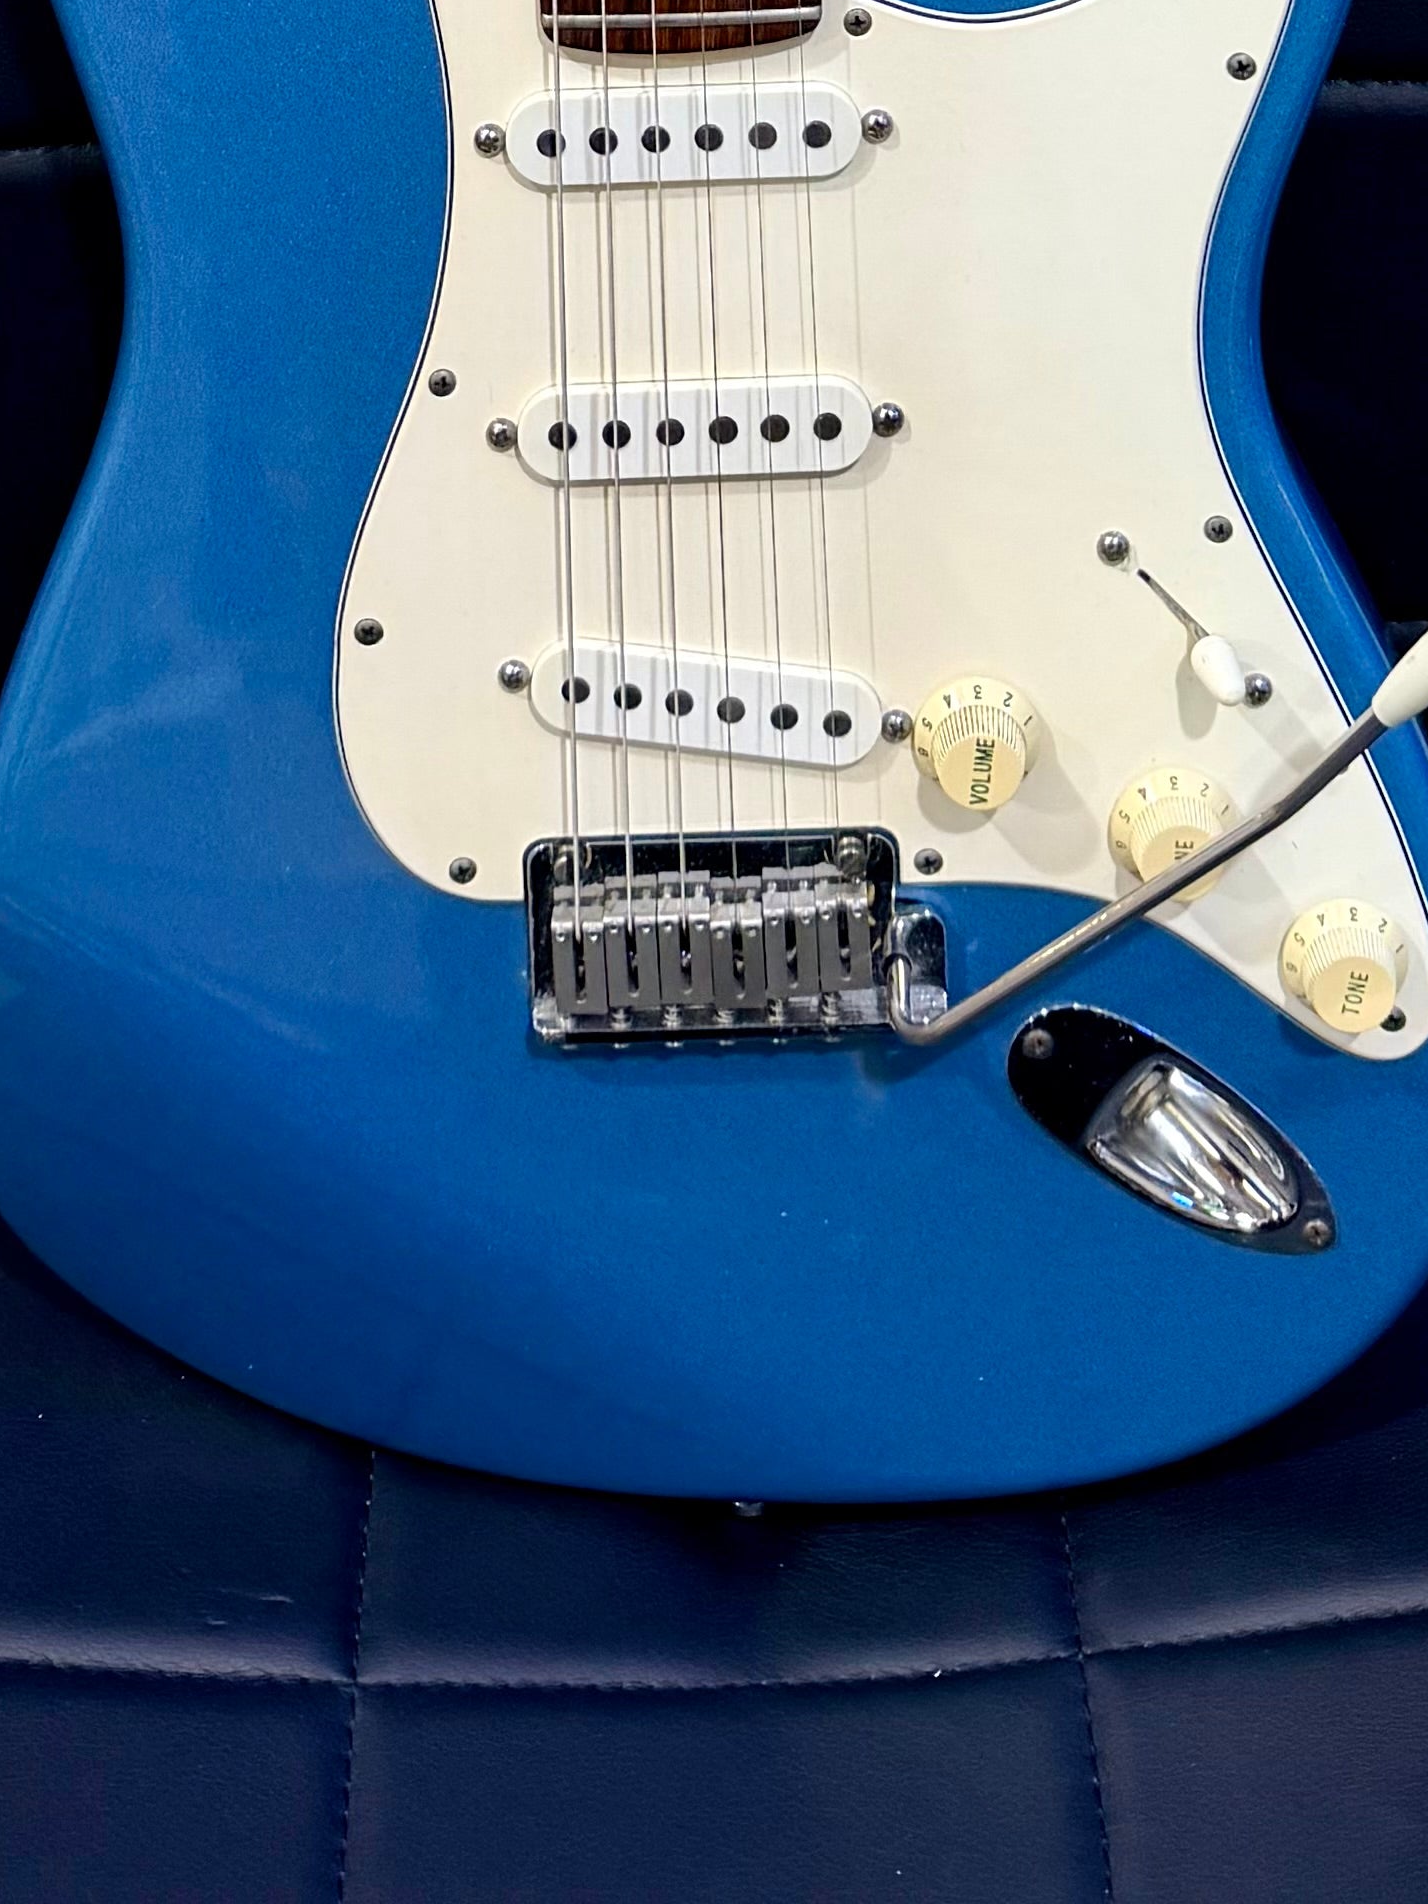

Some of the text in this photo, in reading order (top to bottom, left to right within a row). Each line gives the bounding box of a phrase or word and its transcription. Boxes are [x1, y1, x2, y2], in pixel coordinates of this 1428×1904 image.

[969, 738, 995, 805] VOLUME
[1174, 839, 1194, 860] NE
[1341, 971, 1369, 1015] TONE
